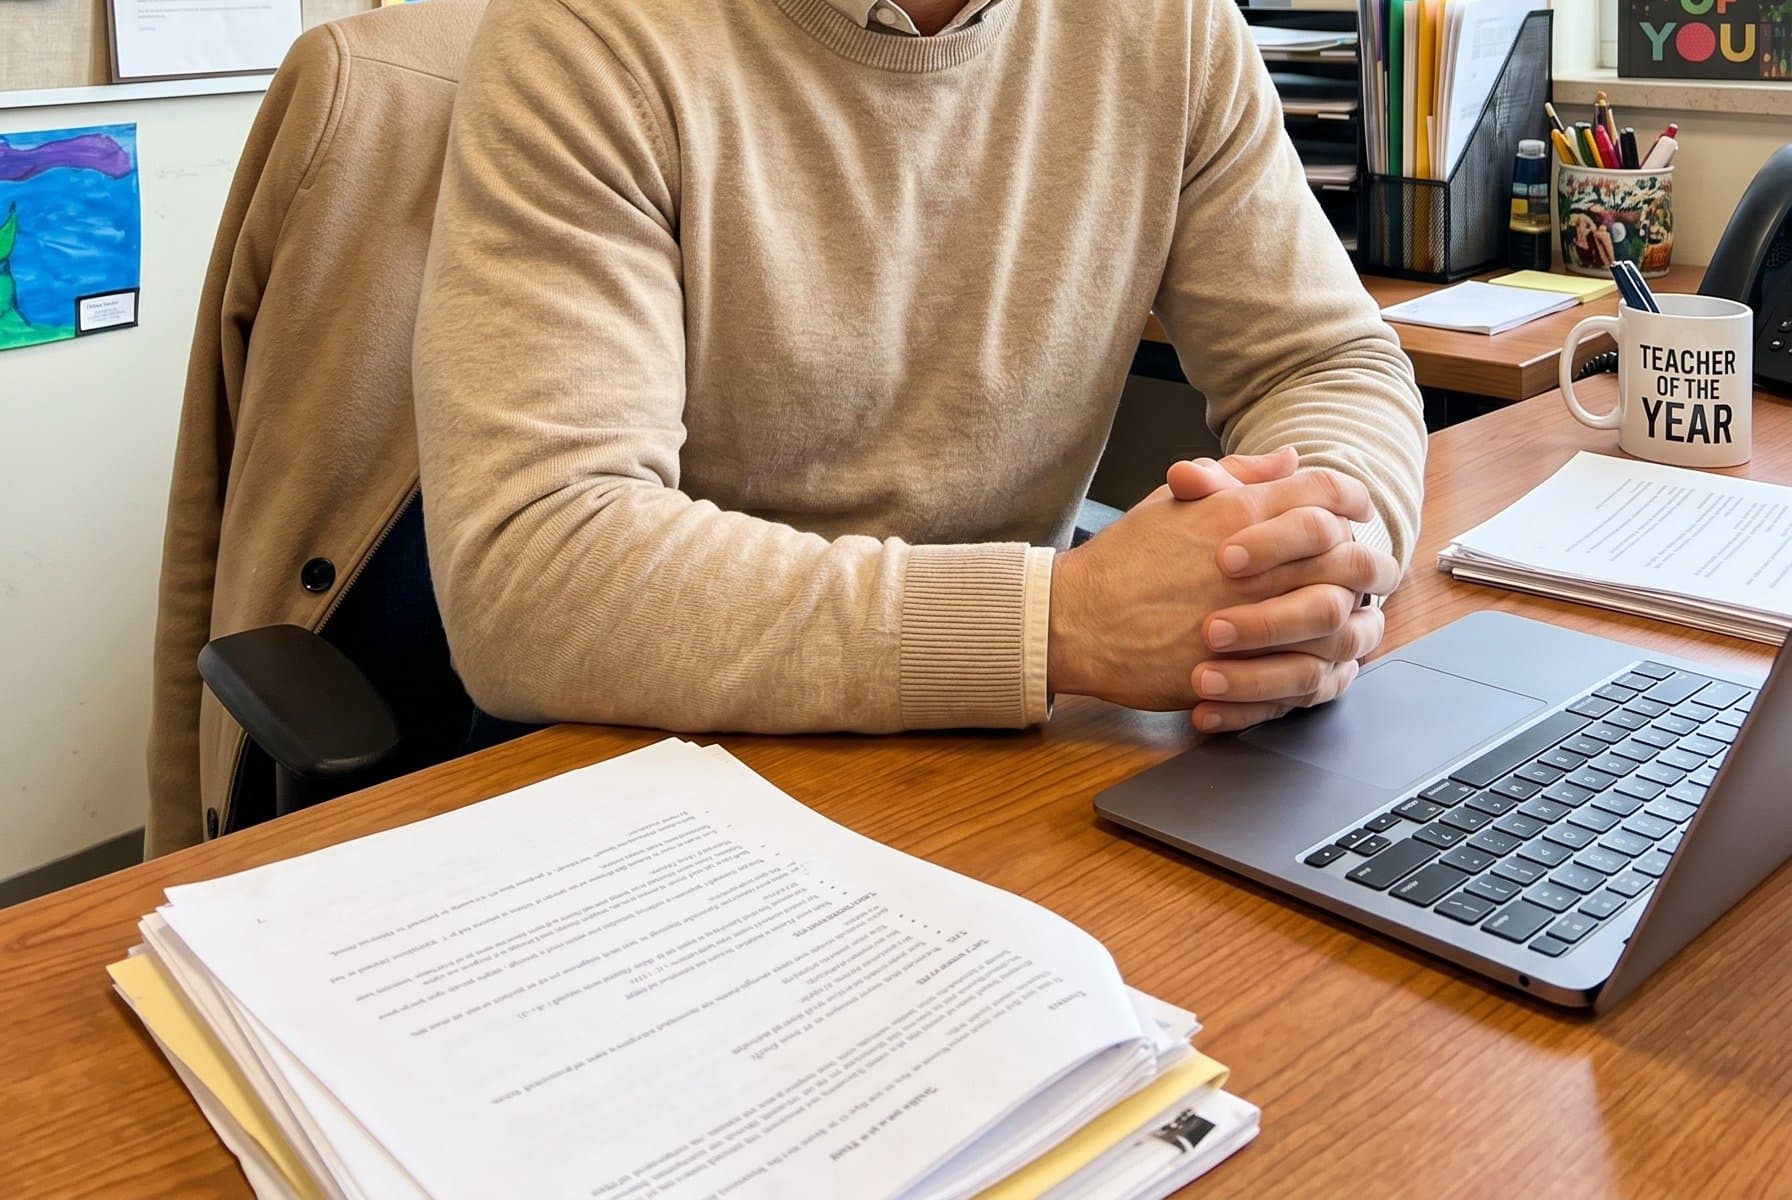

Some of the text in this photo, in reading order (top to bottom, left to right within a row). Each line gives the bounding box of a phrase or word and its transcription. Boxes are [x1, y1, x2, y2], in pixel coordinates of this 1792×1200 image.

[1640, 21, 1756, 62] YOU
[1640, 344, 1736, 375] TEACHER
[1657, 375, 1720, 400] OF THE
[1641, 397, 1733, 444] YEAR
